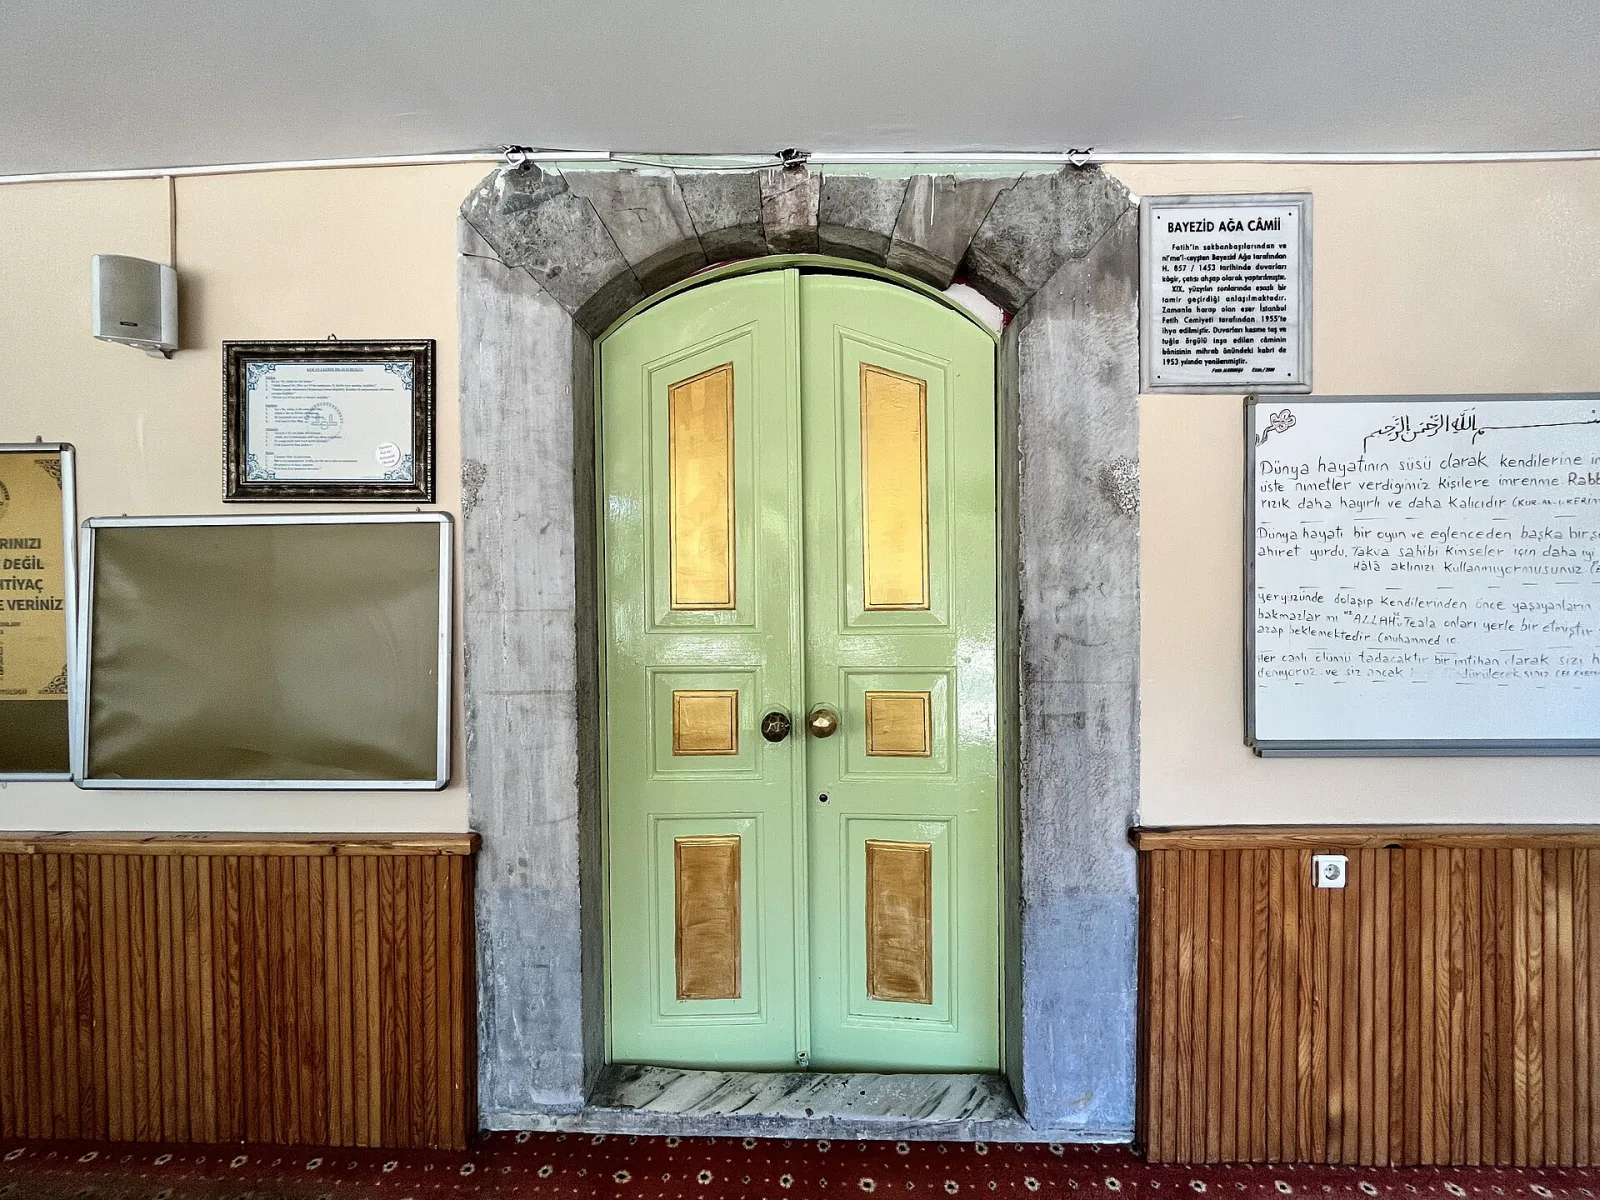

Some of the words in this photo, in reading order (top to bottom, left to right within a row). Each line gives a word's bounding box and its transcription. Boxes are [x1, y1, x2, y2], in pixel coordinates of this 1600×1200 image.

[1168, 218, 1214, 233] BAYEZİD
[1219, 218, 1244, 232] AĞA
[1248, 217, 1280, 231] CÂMİİ
[1212, 253, 1236, 262] Bayezid
[1238, 253, 1251, 261] Ağa
[1200, 275, 1220, 283] ahşap
[1217, 284, 1251, 292] sonlarında
[1188, 296, 1220, 304] geçirdiği
[1226, 294, 1286, 303] anlaşılmaktadır.
[1197, 306, 1216, 314] harap
[1260, 303, 1286, 311] İstanbul
[1184, 316, 1213, 324] Cemiyeti
[1162, 327, 1176, 335] ihya
[1268, 326, 1277, 334] taş
[1162, 338, 1179, 346] tuğla
[1181, 358, 1202, 366] yılında
[1204, 358, 1248, 366] yenilenmiştir.
[1260, 460, 1309, 480] Dünya
[1318, 455, 1389, 477] hayatının
[1400, 457, 1431, 470] süsü
[1500, 452, 1583, 467] kendilerine
[1260, 480, 1285, 492] üste
[1295, 478, 1351, 491] nimetler
[1261, 498, 1291, 509] rızık
[1298, 498, 1332, 509] daha
[1340, 496, 1380, 512] hayırlı
[1388, 500, 1401, 508] ve
[1409, 497, 1442, 509] daha
[1257, 527, 1298, 543] Dünya
[1303, 526, 1343, 543] hayatı
[1354, 526, 1372, 539] bir
[1377, 531, 1406, 542] oyun
[1411, 531, 1424, 539] ve
[1521, 525, 1563, 542] başka
[1258, 544, 1303, 557] ahiret
[1352, 546, 1390, 557] Takva
[1398, 545, 1438, 558] sahibi
[1514, 548, 1536, 557] için
[1543, 545, 1577, 557] daha
[3, 555, 44, 569] DEĞİL
[7, 596, 63, 610] VERİNİZ
[1334, 592, 1373, 608] dolaşıp
[1476, 598, 1506, 610] önce
[1512, 599, 1592, 614] yaşayanların
[1258, 609, 1321, 622] bakmazlar
[1404, 616, 1436, 628] Teala
[1444, 616, 1477, 629] onları
[1483, 620, 1515, 632] yerle
[1520, 618, 1538, 632] bir
[1257, 625, 1283, 638] azap
[1289, 624, 1371, 641] beklemektedir
[1282, 653, 1307, 663] canlı
[1359, 652, 1429, 663] tadacaktır
[1435, 655, 1450, 665] bir
[1455, 655, 1500, 665] imtihan
[1559, 655, 1583, 665] sizi
[1346, 665, 1361, 676] siz
[1367, 667, 1403, 677] ancak
